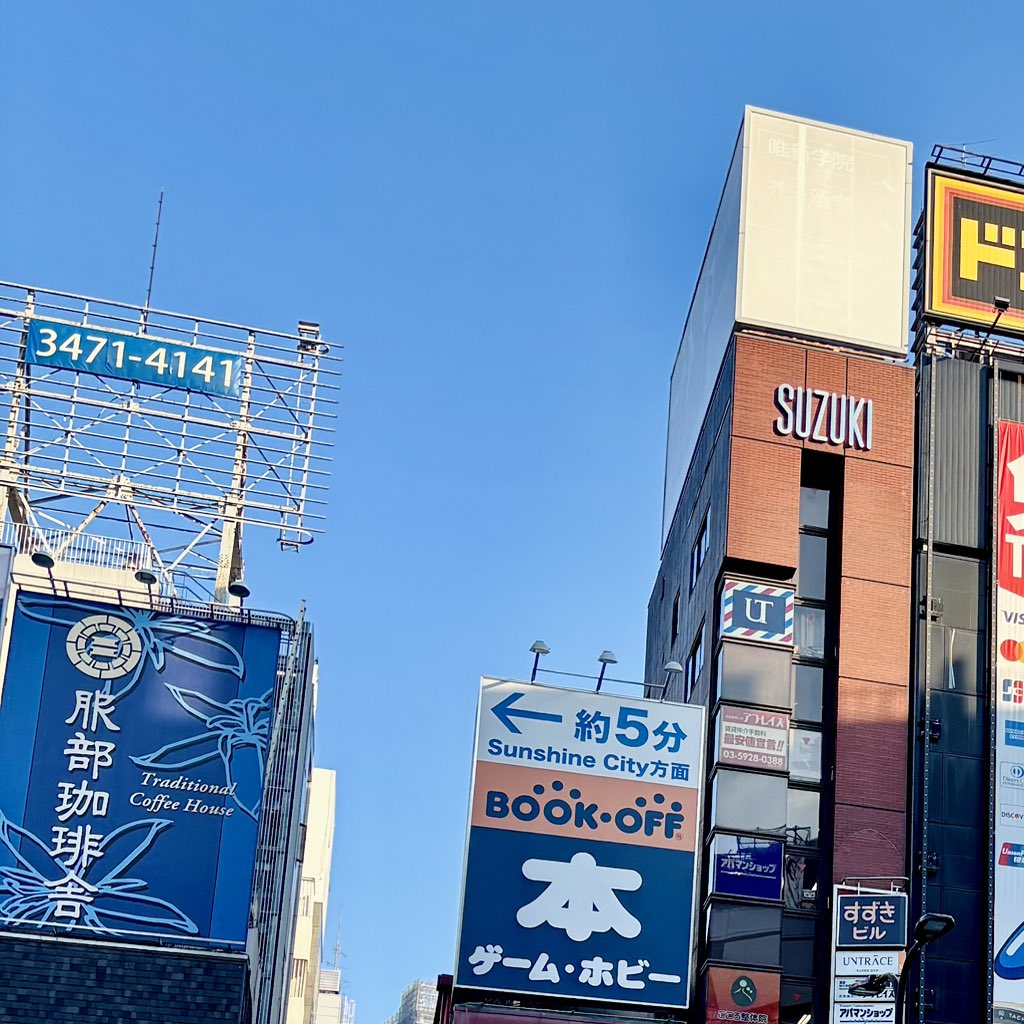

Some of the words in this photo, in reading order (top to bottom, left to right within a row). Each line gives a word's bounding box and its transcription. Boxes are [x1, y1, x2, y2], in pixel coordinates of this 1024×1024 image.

[36, 328, 234, 388] 3471-4141
[775, 383, 874, 450] SUZUKI
[574, 706, 688, 754] 約5分
[488, 738, 597, 768] Sunshine
[603, 753, 690, 782] City方面
[141, 771, 237, 797] Traditional
[44, 690, 121, 919] 服部珈琲舎
[129, 791, 180, 813] Coffee
[184, 798, 235, 818] House
[720, 858, 777, 874] アパマンショップ
[516, 852, 644, 942] 本
[844, 901, 895, 924] すずき
[852, 926, 887, 940] ビル
[468, 944, 681, 989] ゲーム・ホビー
[717, 1010, 769, 1024] こころ整体院
[839, 1008, 893, 1018] アパマンショップ
